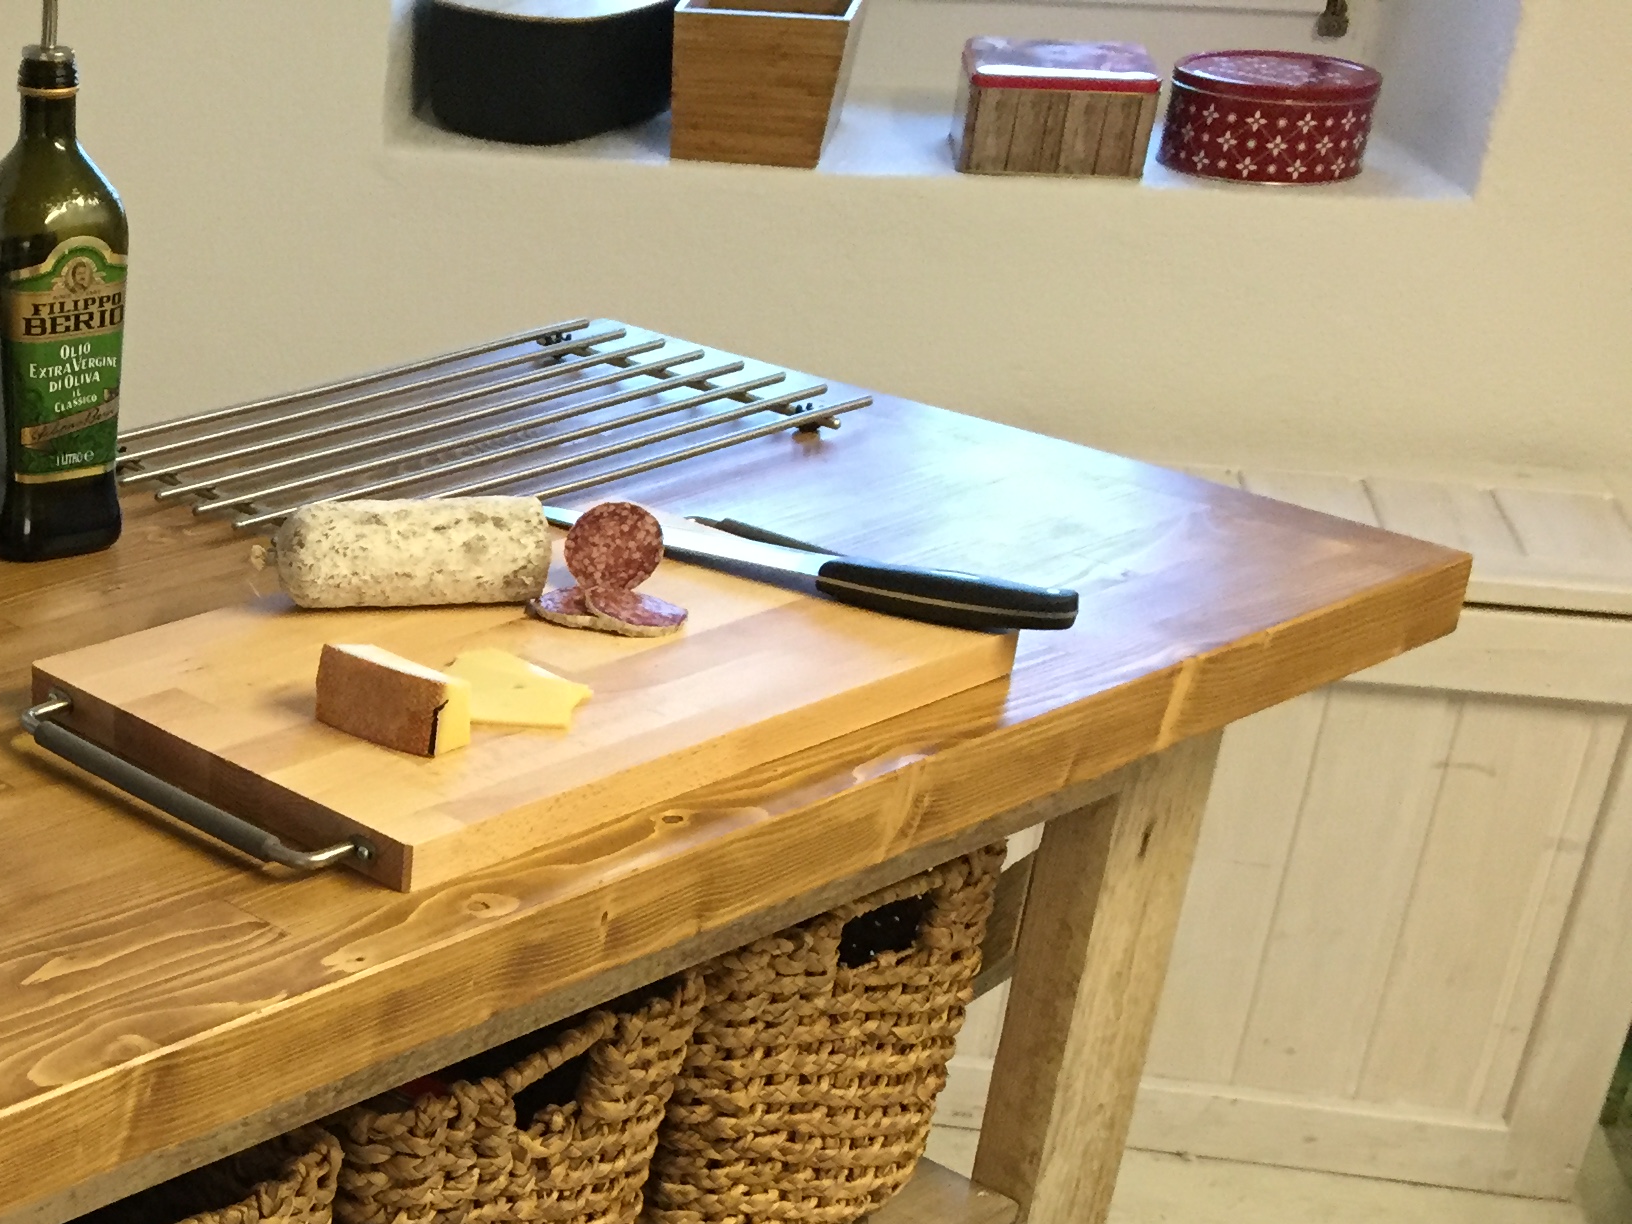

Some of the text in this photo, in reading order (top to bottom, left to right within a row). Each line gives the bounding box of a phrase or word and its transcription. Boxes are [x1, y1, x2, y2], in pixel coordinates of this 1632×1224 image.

[31, 292, 122, 316] FILIPPO
[22, 304, 124, 336] BERIO
[60, 342, 91, 360] OLIO
[49, 371, 101, 392] DI OLIVA
[54, 394, 98, 413] CLASSICO
